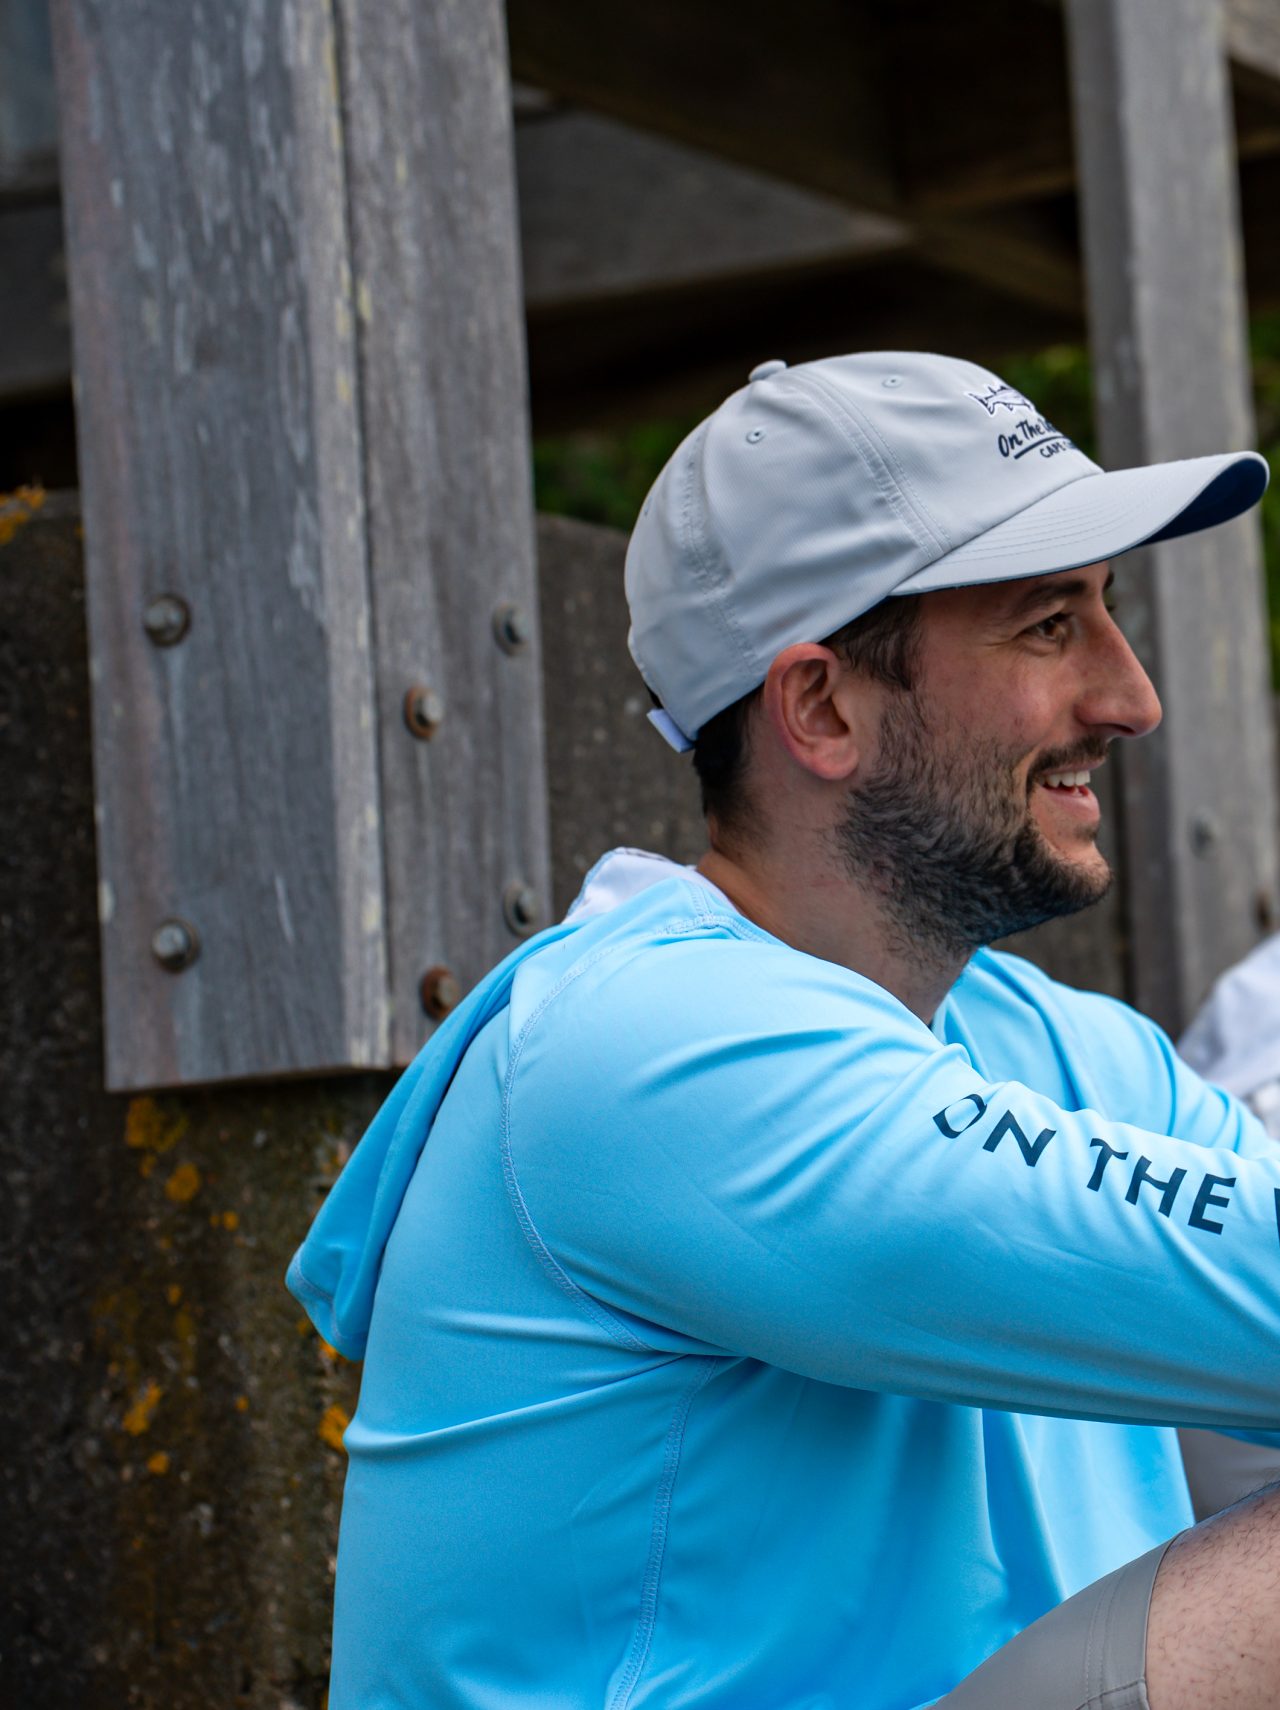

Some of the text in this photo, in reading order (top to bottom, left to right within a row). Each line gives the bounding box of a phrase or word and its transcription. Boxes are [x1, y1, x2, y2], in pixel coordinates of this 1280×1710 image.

[998, 433, 1022, 457] On
[1016, 418, 1045, 440] The
[932, 1093, 1056, 1167] ON
[1086, 1138, 1236, 1235] THE
